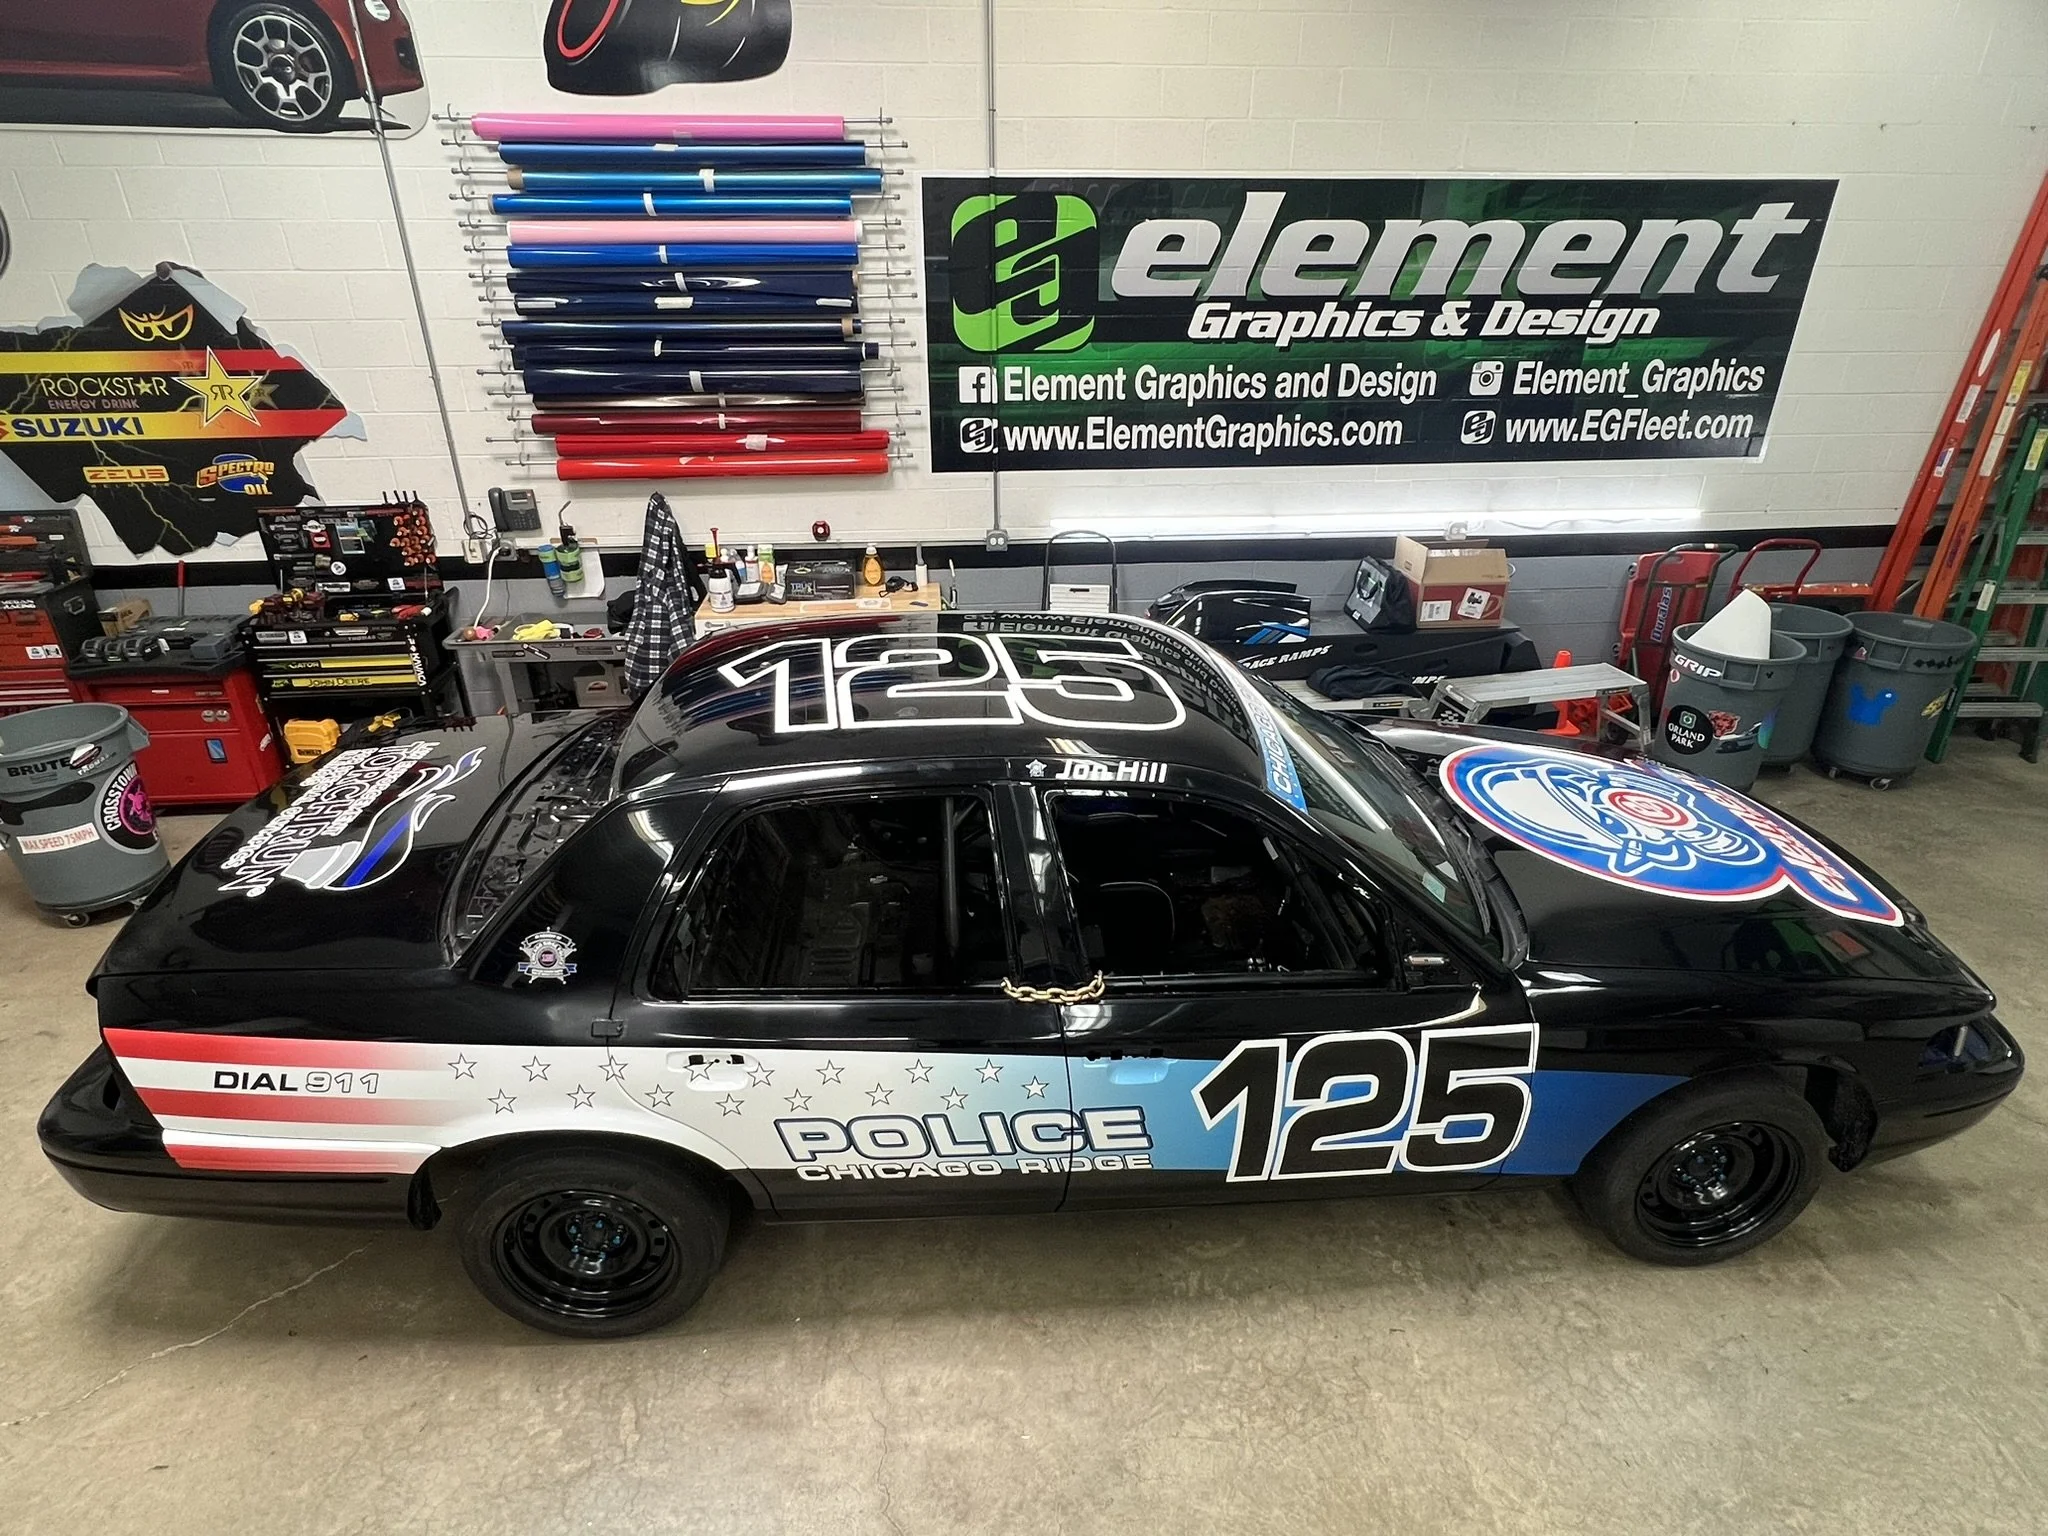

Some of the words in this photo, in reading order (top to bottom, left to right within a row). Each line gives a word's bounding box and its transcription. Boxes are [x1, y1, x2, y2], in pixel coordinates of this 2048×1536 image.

[1110, 191, 1809, 301] element
[1187, 303, 1425, 347] Graphics
[1429, 303, 1469, 337] &
[1474, 300, 1661, 344] Design
[1004, 365, 1125, 402] Element
[1134, 363, 1270, 406] Graphics
[1276, 366, 1328, 399] and
[1337, 363, 1438, 403] Design
[1513, 358, 1765, 400] Element_Graphics
[48, 398, 98, 410] ENERGY
[101, 398, 140, 409] DRINK
[11, 416, 144, 438] SUZUKI
[1003, 415, 1402, 453] www.ElementGraphics.com
[1505, 408, 1754, 443] www.EGFleet.com
[87, 468, 167, 480] ZEUS
[197, 461, 275, 488] SPECTRO
[243, 483, 273, 495] OIL
[1651, 586, 1673, 642] Duralas
[1278, 645, 1333, 664] RAMPS
[1674, 654, 1723, 680] GRIP
[308, 679, 335, 687] JOHN
[336, 678, 371, 686] DEERE
[716, 632, 1187, 732] 125
[1668, 722, 1706, 743] ORLAND
[1671, 735, 1695, 748] PARK
[7, 757, 71, 777] BRUTE
[1116, 760, 1168, 784] Hill
[294, 741, 425, 821] TORCH
[40, 834, 65, 850] SPEED
[218, 821, 331, 891] RUN
[214, 1071, 299, 1092] DIAL
[304, 1071, 380, 1094] 911
[1191, 1022, 1539, 1183] 125
[774, 1106, 1154, 1162] POLICE
[796, 1159, 1003, 1181] CHICAGO
[1015, 1153, 1154, 1175] RIDGE
